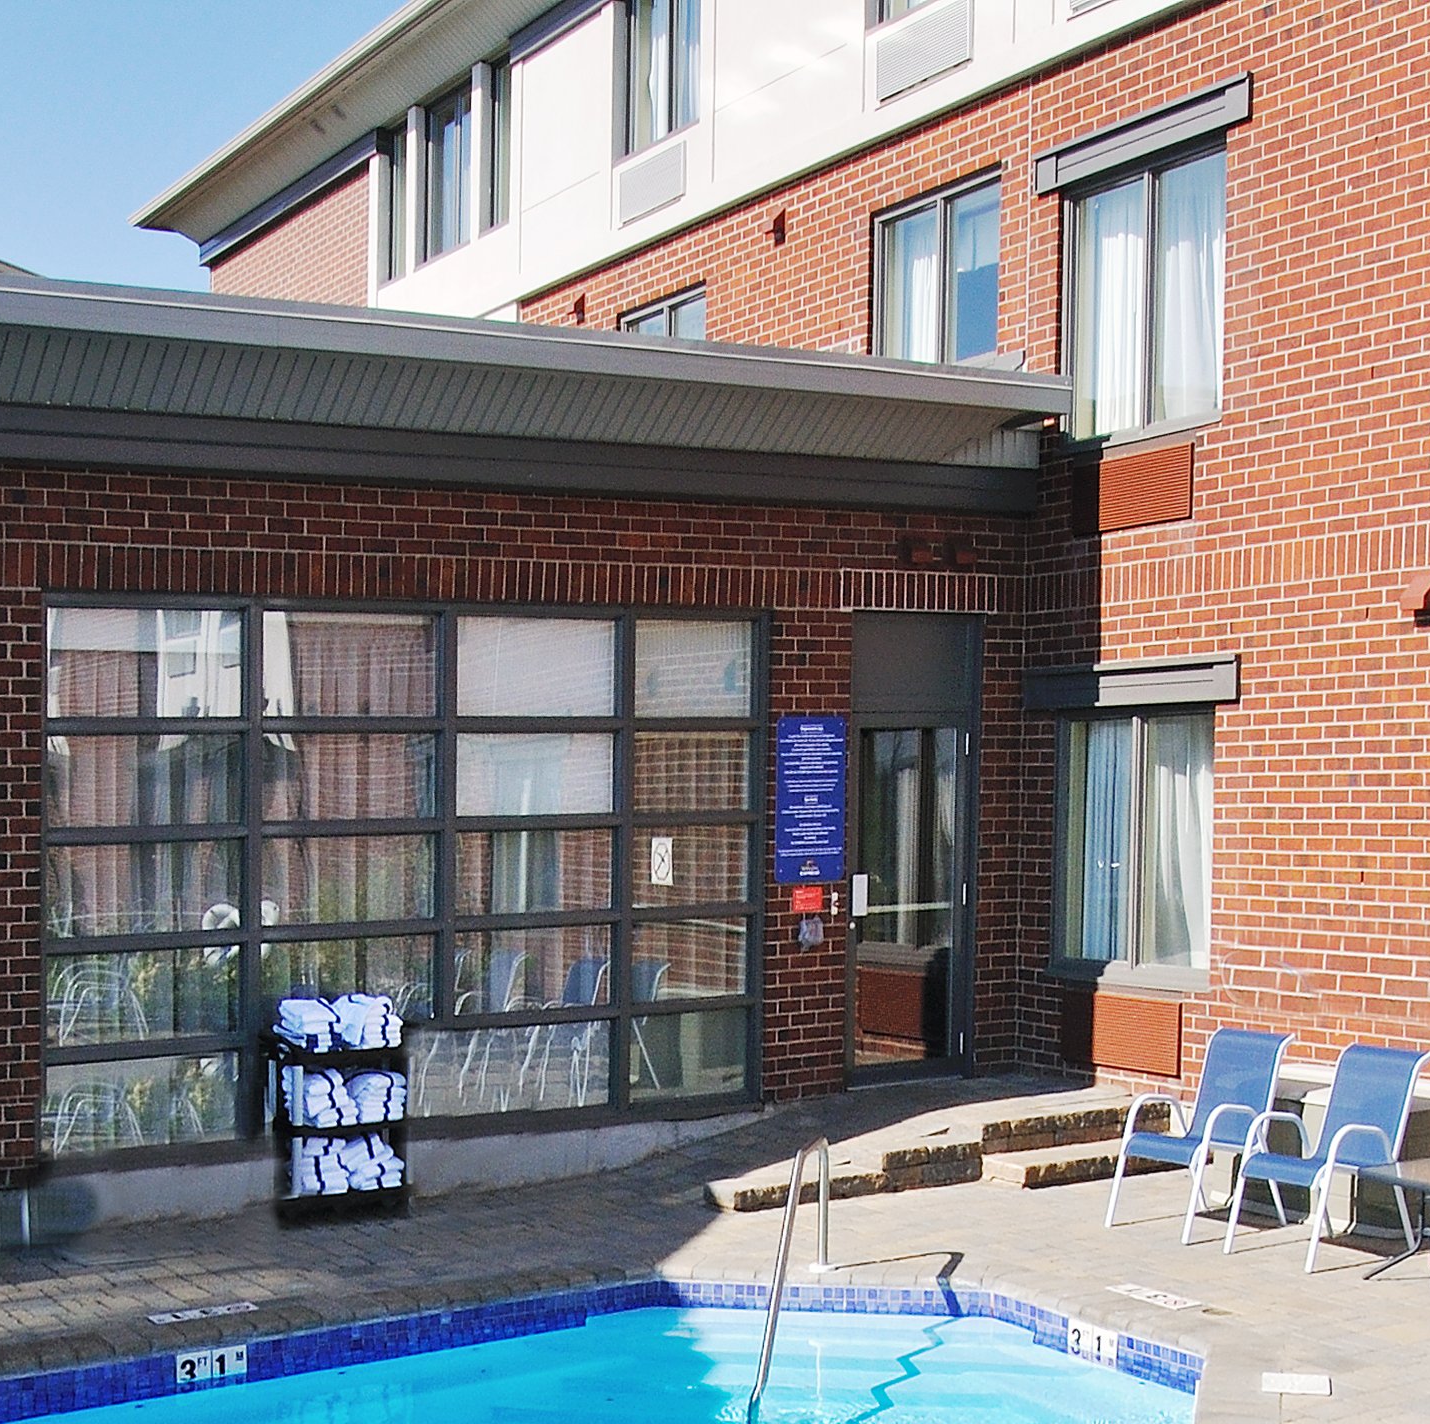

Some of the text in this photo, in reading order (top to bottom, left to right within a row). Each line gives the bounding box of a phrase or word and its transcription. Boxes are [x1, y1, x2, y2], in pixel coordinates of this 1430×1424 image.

[1096, 1335, 1101, 1352] 1
[180, 1358, 196, 1381] 3
[215, 1353, 226, 1375] 1
